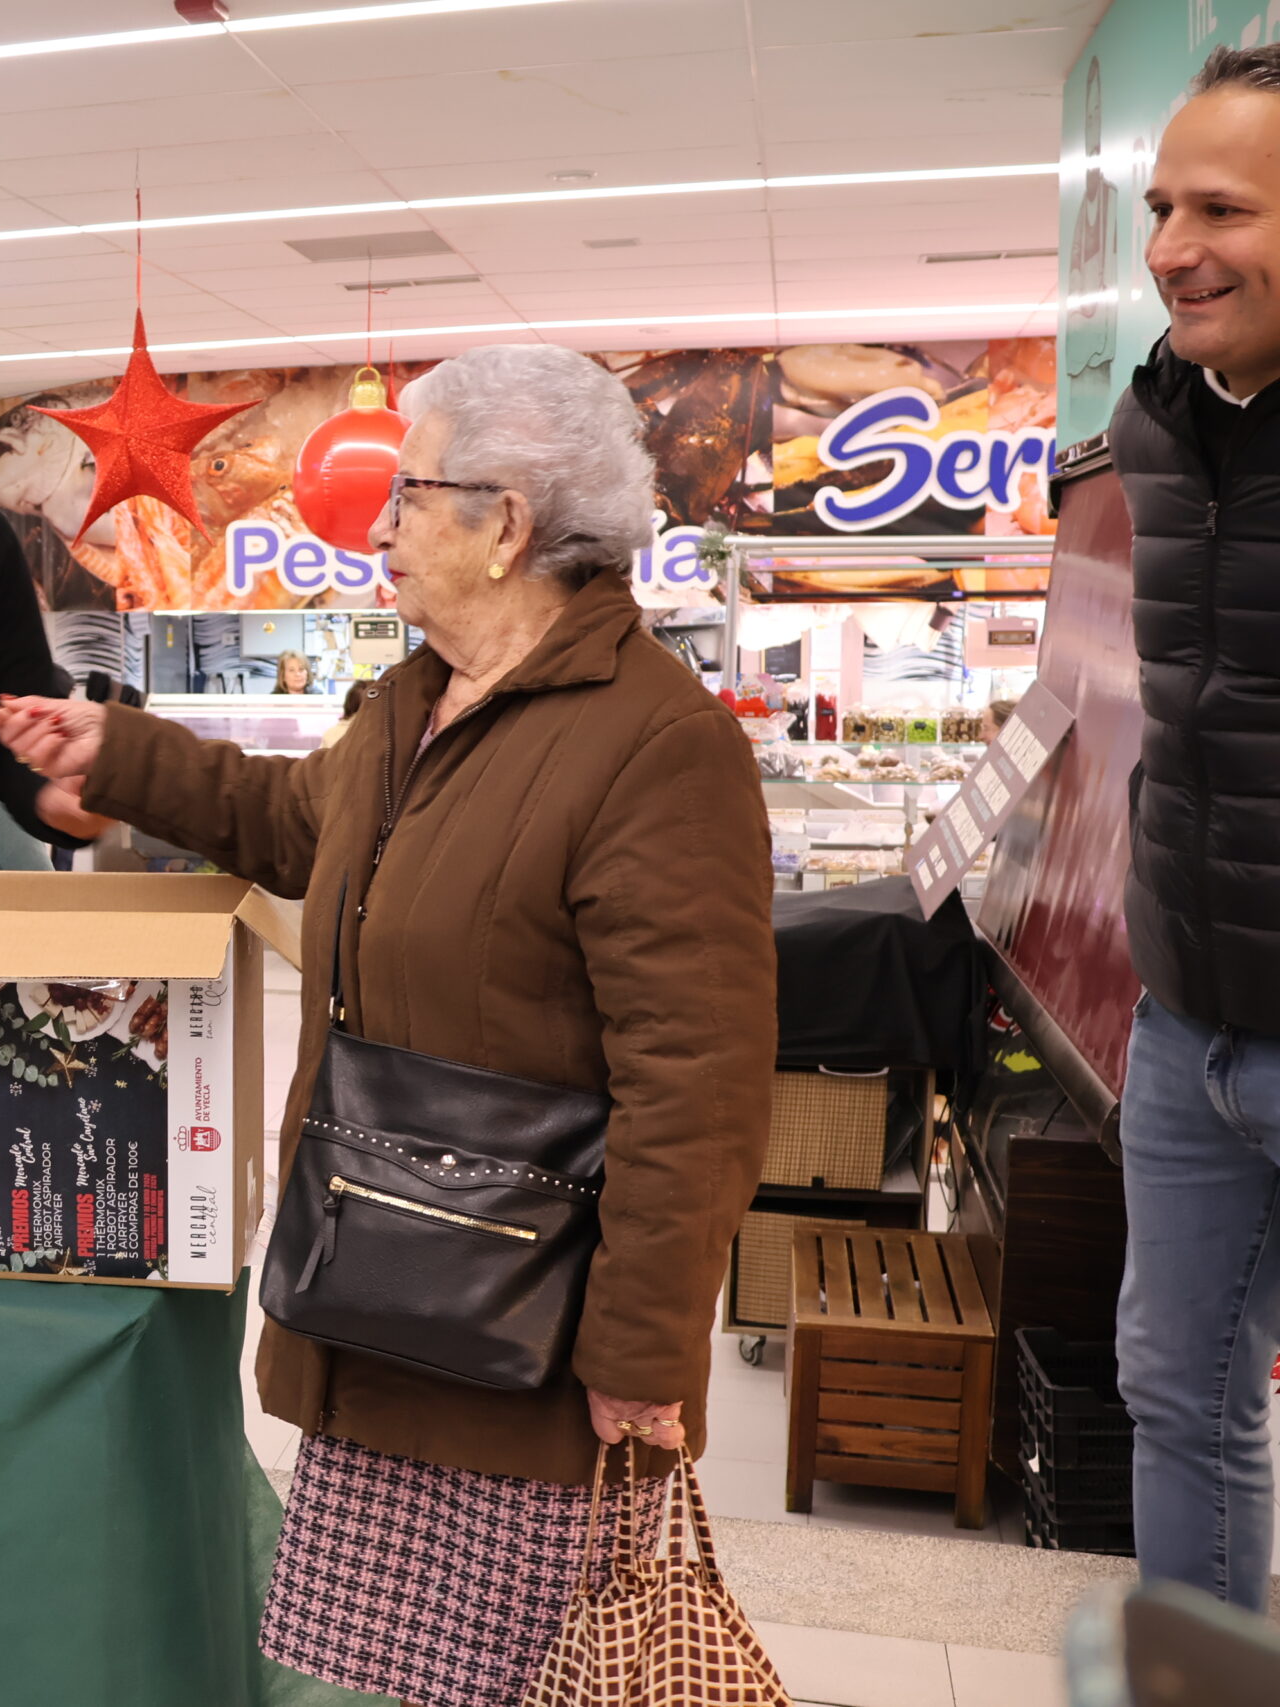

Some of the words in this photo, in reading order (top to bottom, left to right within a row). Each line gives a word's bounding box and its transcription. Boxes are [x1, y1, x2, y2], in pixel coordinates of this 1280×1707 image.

[825, 396, 1056, 522] Ser
[189, 985, 203, 1038] MERCADO
[194, 1057, 202, 1121] AYUNTAMIENTO
[203, 1109, 210, 1121] DE
[15, 1127, 36, 1164] Central
[76, 1097, 95, 1142] Cayetano
[9, 1144, 28, 1187] Mercado
[42, 1143, 52, 1207] ASPIRADOR
[72, 1143, 89, 1186] Mercado
[83, 1144, 98, 1162] San
[106, 1138, 116, 1209] ASPIRADOR
[128, 1140, 138, 1169] 100€
[128, 1171, 138, 1188] DE
[12, 1189, 31, 1252] PREMIOS
[33, 1180, 42, 1247] THERMOMIX
[43, 1208, 52, 1248] ROBOT
[53, 1193, 63, 1247] AIRFRYER
[77, 1193, 94, 1256] PREMIOS
[96, 1179, 105, 1249] THERMOMIX
[106, 1210, 116, 1250] ROBOT
[118, 1192, 127, 1249] AIRFRYER
[128, 1190, 139, 1250] COMPRAS
[190, 1194, 208, 1259] MERCADO
[196, 1185, 218, 1244] central
